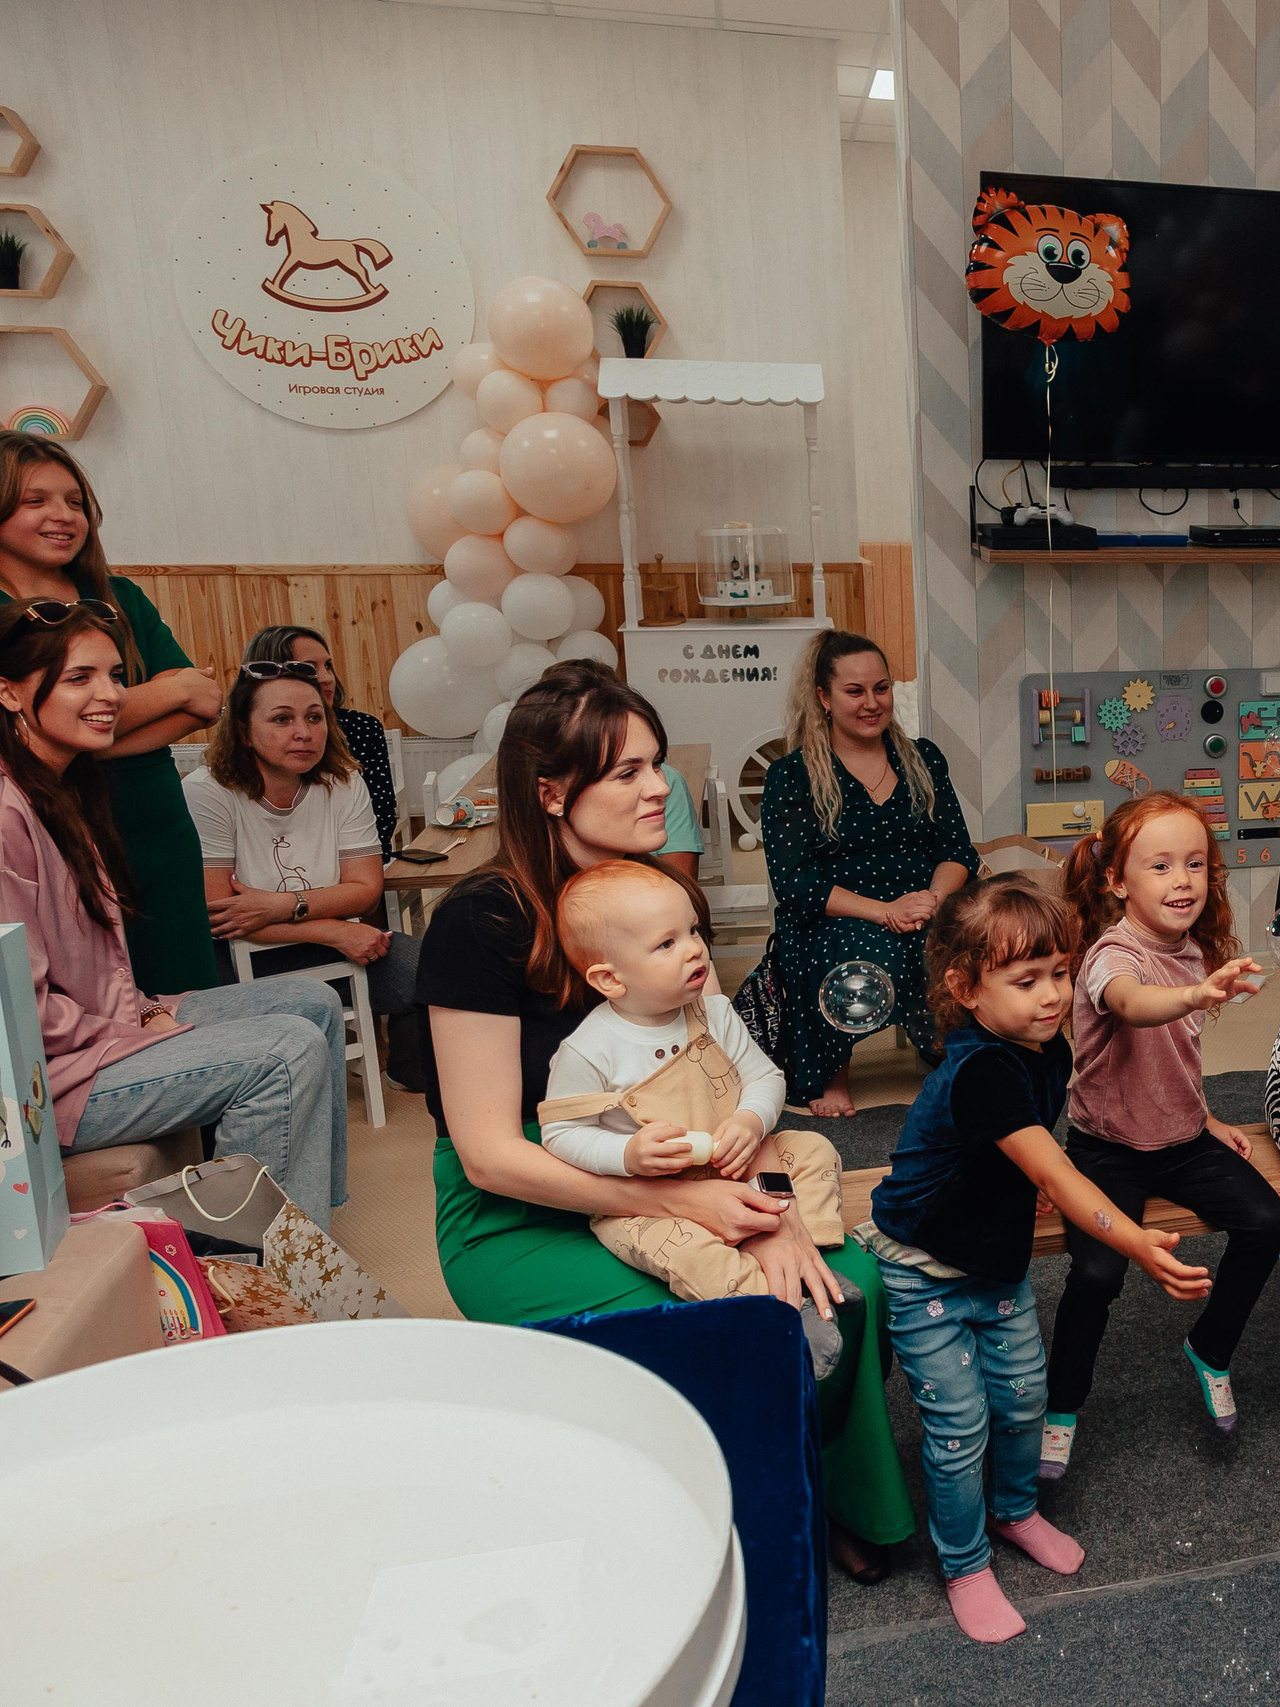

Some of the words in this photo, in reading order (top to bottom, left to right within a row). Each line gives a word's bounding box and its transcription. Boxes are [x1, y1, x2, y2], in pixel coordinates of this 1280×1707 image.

[211, 308, 444, 381] Чики-Брики
[288, 383, 341, 396] Игровая
[343, 386, 385, 397] студия
[682, 644, 695, 660] С
[700, 644, 760, 660] ДНЕМ
[657, 666, 778, 684] РОЖДЕНИЯ!
[1236, 848, 1247, 865] 5
[1260, 847, 1271, 864] 6
